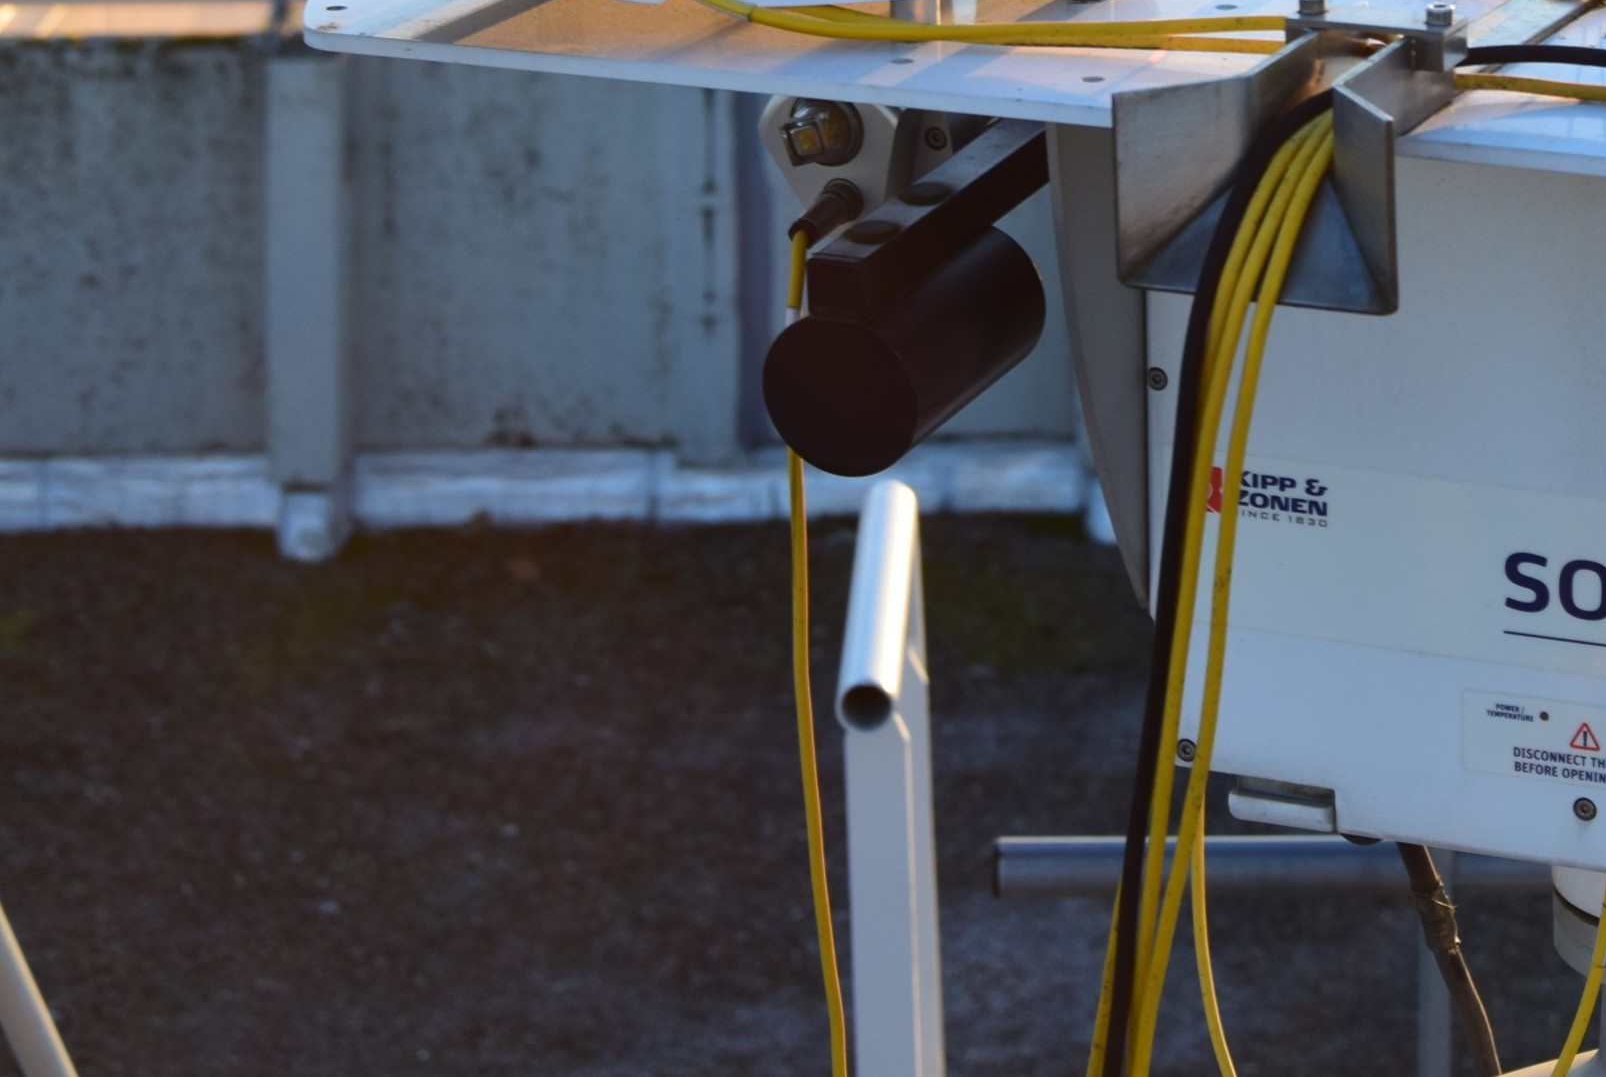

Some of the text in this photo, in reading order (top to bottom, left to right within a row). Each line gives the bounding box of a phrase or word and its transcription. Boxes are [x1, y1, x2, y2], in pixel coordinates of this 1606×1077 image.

[1305, 478, 1328, 497] &
[1238, 489, 1328, 517] ZONEN
[1240, 510, 1328, 528] INCE 1830
[1486, 710, 1534, 722] TEMPERATURE
[1513, 747, 1587, 766] DISCONNECT
[1514, 761, 1558, 777] BEFORE
